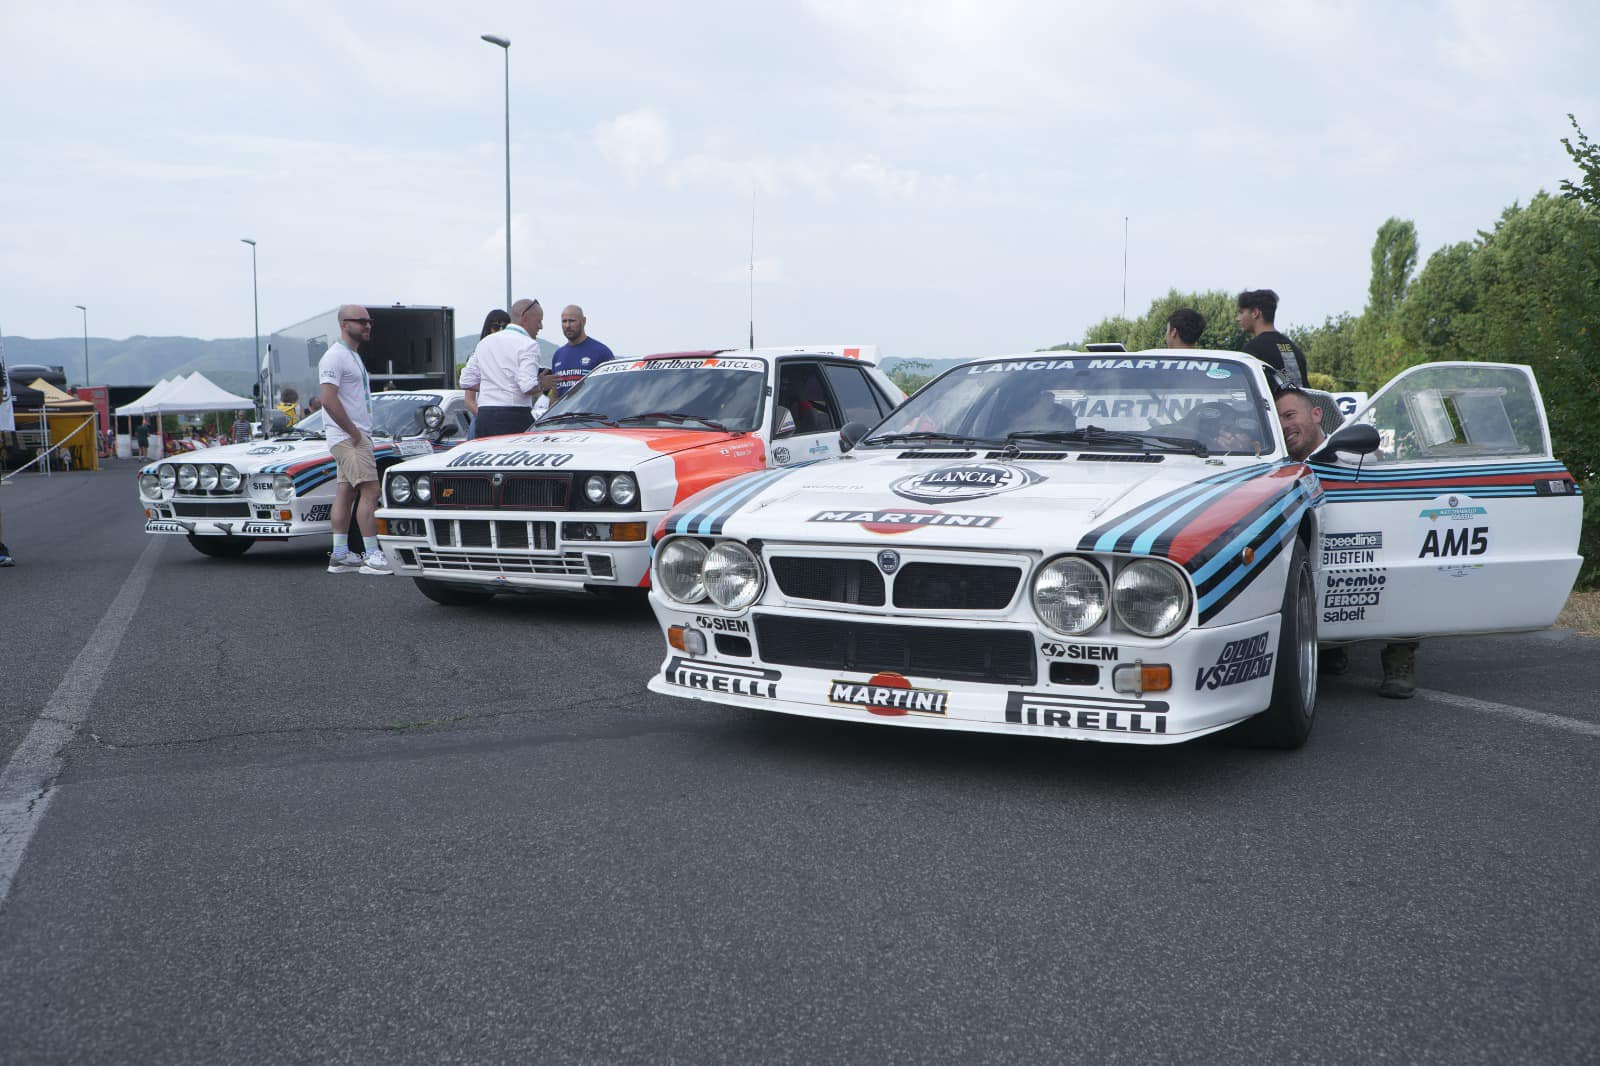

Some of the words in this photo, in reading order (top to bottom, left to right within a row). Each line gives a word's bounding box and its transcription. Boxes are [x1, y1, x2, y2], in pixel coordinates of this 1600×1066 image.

[643, 359, 704, 370] Marlboro
[716, 360, 750, 369] ATCL
[968, 360, 1075, 375] LANCIA
[1088, 359, 1219, 371] MARTINI
[446, 450, 574, 468] Marlboro
[927, 471, 996, 484] LANCIA
[252, 482, 273, 490] SIEM
[815, 511, 994, 527] MARTINI
[241, 521, 293, 534] PIRELLI
[1324, 533, 1377, 549] speedline
[1418, 526, 1489, 558] AM5
[1322, 551, 1374, 565] BILSTEIN
[1327, 573, 1387, 588] brembo
[1327, 594, 1377, 607] FERODO
[1323, 607, 1365, 622] sabelt
[713, 618, 750, 633] SIEM
[1067, 645, 1119, 661] SIEM
[1219, 634, 1268, 664] OLIO
[665, 656, 782, 698] PIRELLI
[832, 683, 944, 712] MARTINI
[1005, 691, 1170, 734] PIRELLI
